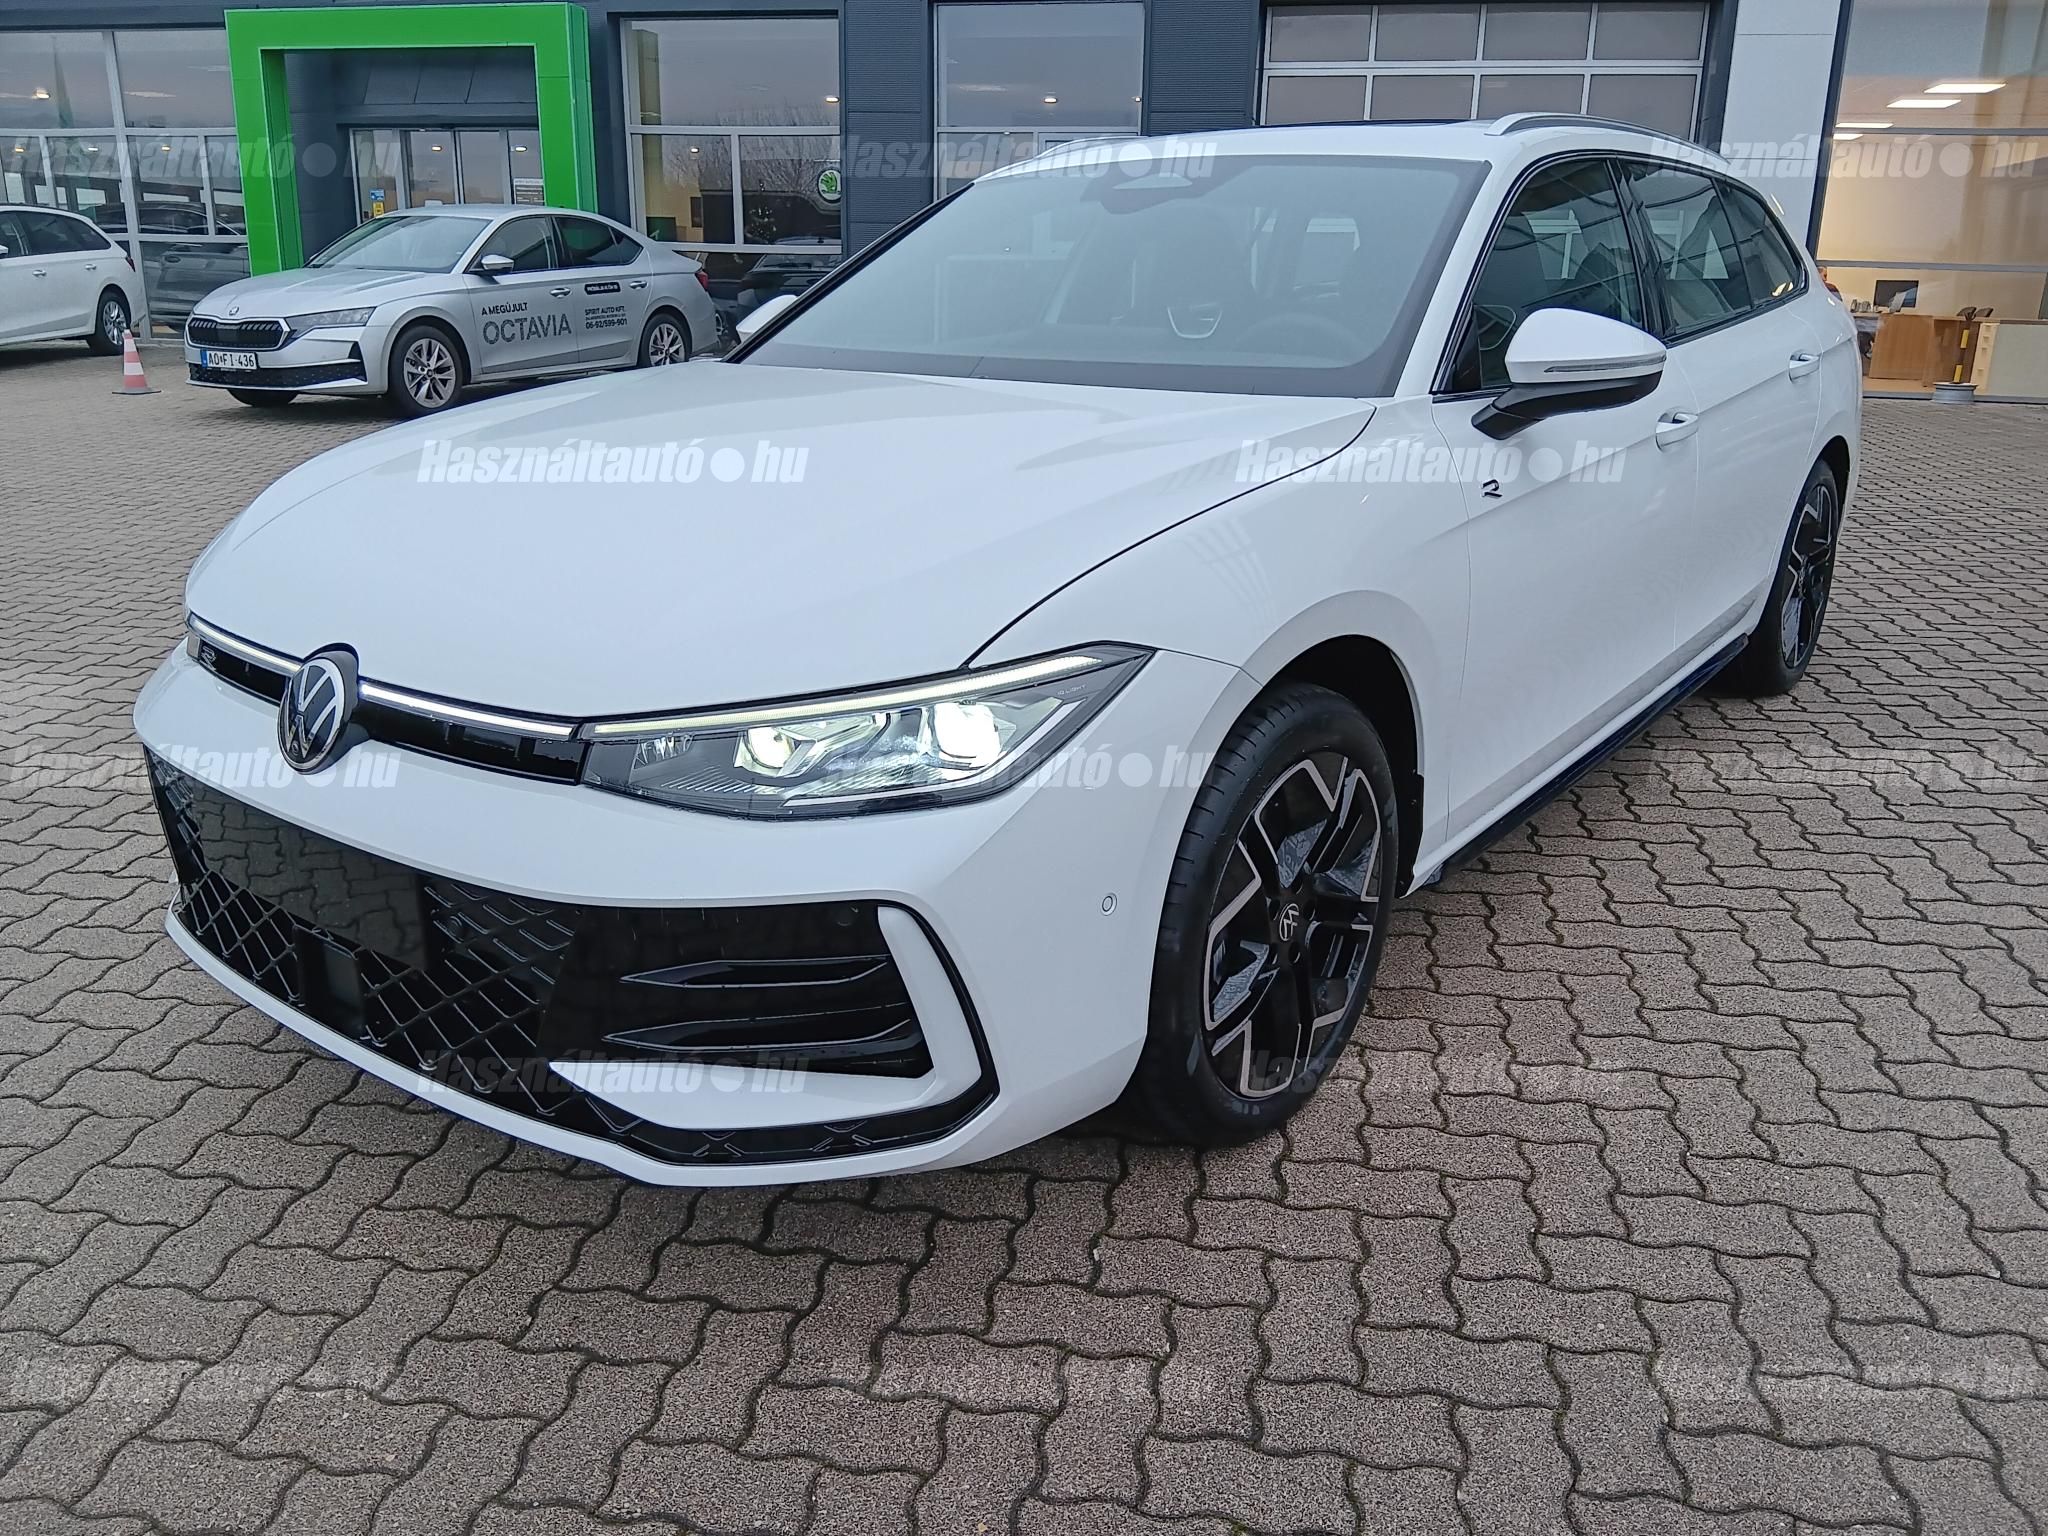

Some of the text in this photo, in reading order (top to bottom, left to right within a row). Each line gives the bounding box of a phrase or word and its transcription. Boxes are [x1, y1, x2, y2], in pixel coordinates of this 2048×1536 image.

[481, 302, 528, 315] A MEGÚJULT
[601, 306, 615, 314] AUTO
[482, 313, 572, 344] OCTAVIA
